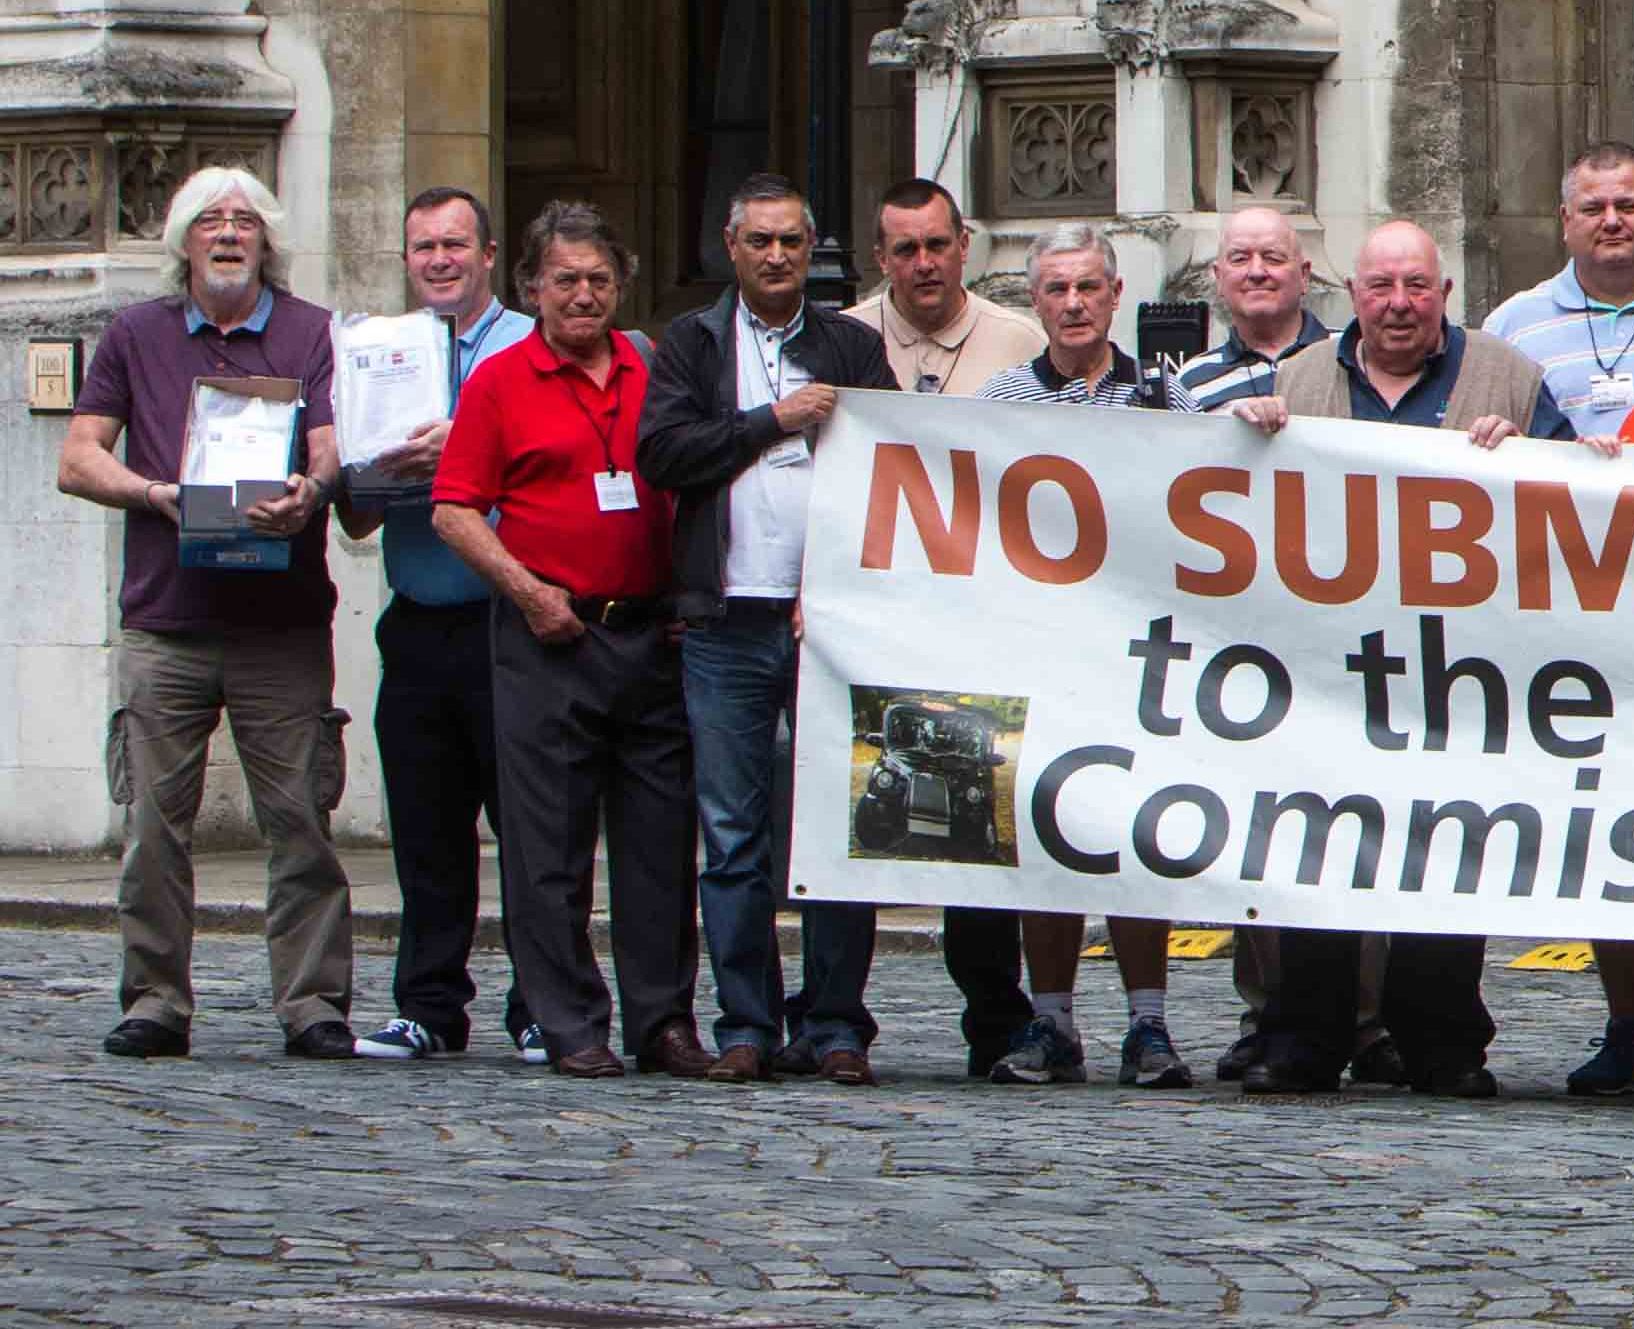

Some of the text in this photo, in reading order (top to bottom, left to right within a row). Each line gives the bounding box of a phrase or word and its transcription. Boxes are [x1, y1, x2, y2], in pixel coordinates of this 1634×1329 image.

[860, 442, 1108, 585] NO
[1127, 615, 1293, 741] to
[1346, 614, 1615, 759] the
